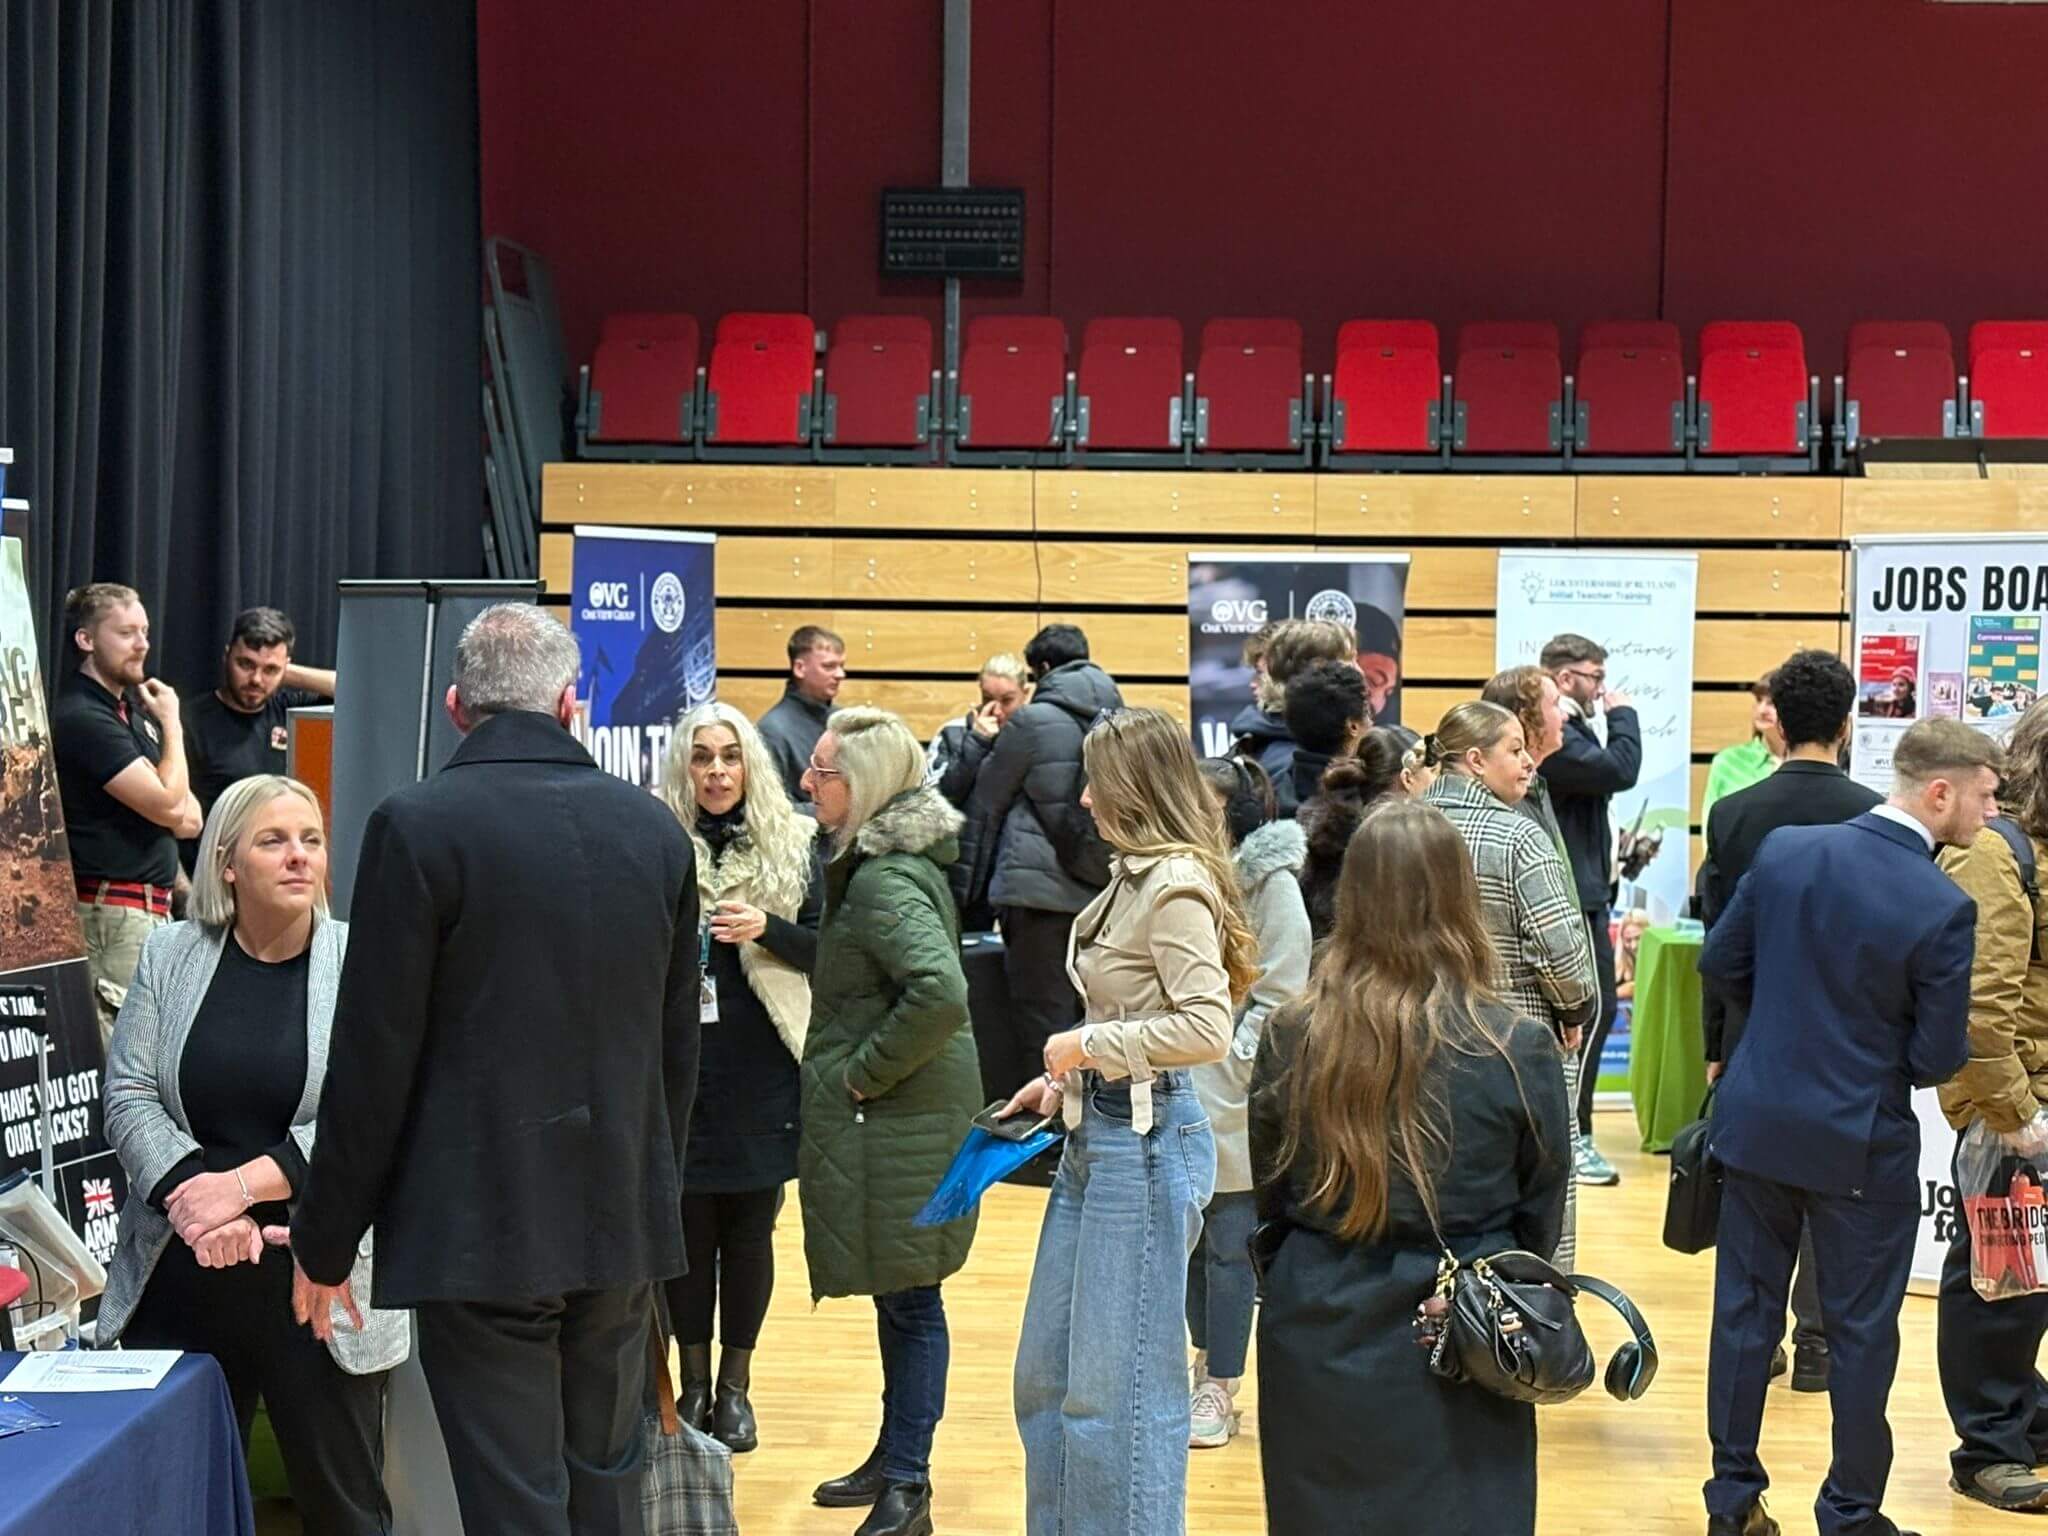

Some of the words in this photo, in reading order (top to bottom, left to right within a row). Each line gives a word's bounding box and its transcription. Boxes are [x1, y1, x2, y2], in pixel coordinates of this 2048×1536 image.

[589, 581, 629, 609] OVG
[1873, 567, 1967, 611] JOBS
[1211, 600, 1268, 622] OVG
[9, 995, 47, 1017] TIM
[0, 1084, 36, 1123] HAVE
[66, 1069, 99, 1105] GOT
[4, 1121, 34, 1158] OUR
[84, 1213, 120, 1250] ARM
